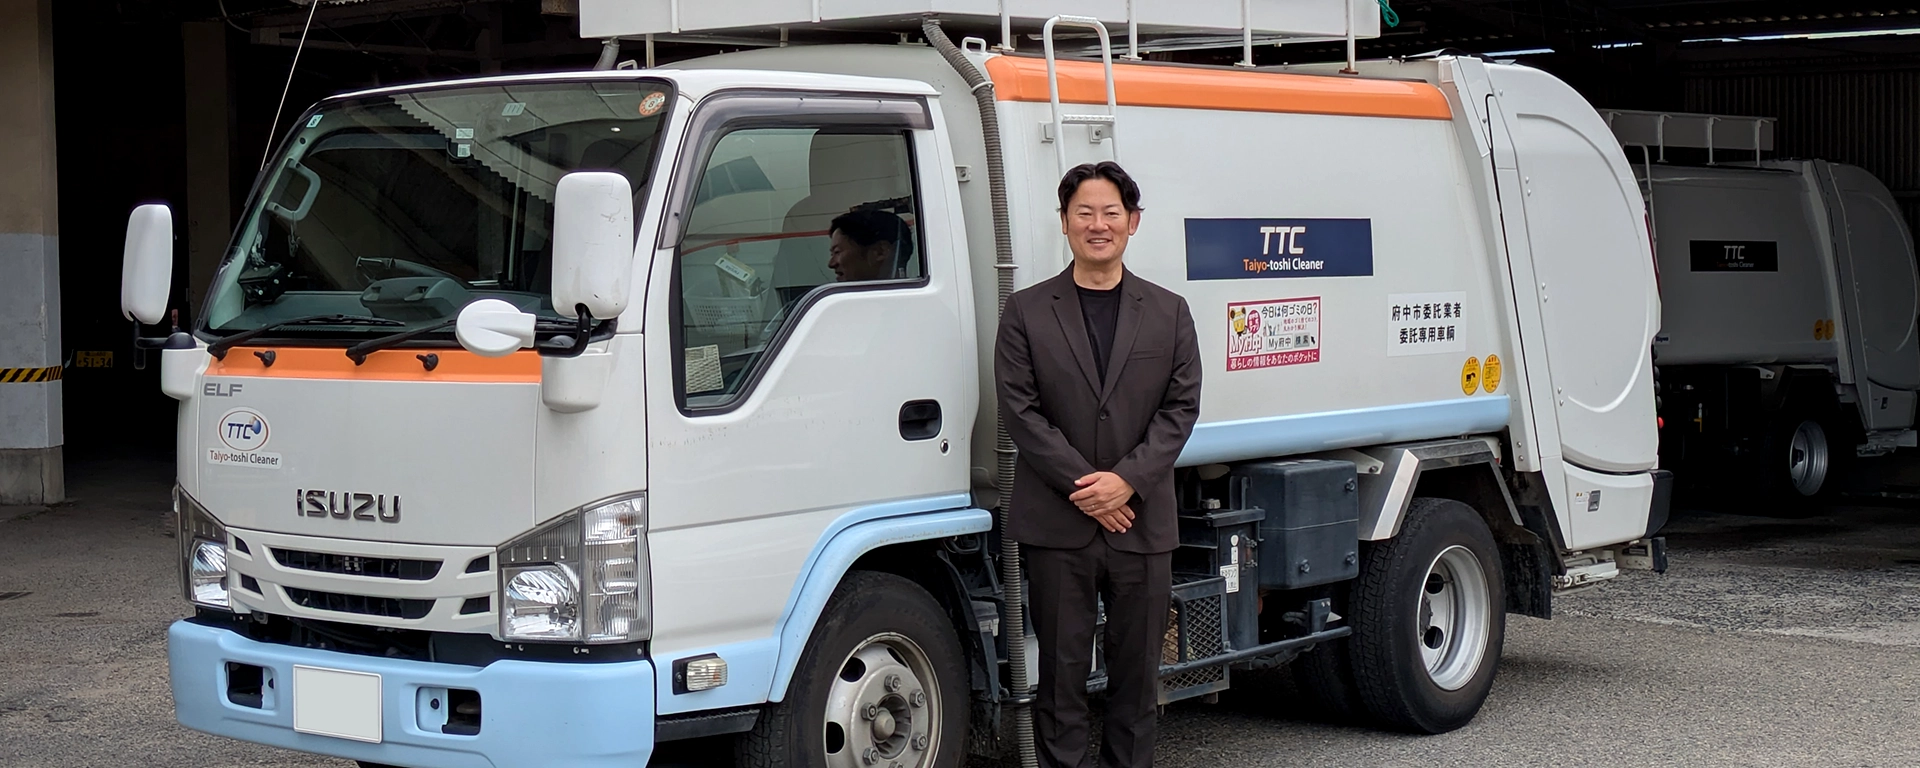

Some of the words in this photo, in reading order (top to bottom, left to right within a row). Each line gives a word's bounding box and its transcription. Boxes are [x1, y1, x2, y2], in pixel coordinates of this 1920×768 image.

[1260, 226, 1306, 255] TTC
[1724, 245, 1745, 259] TTC
[1243, 258, 1291, 274] Taiyo-toshi
[1292, 257, 1324, 271] Cleaner
[1392, 302, 1461, 321] 府中市委託業者
[203, 383, 243, 397] ELF
[227, 422, 252, 439] TTC
[209, 450, 249, 464] Taiyo-toshi
[249, 453, 279, 466] Cleaner
[296, 488, 402, 524] ISUZU
